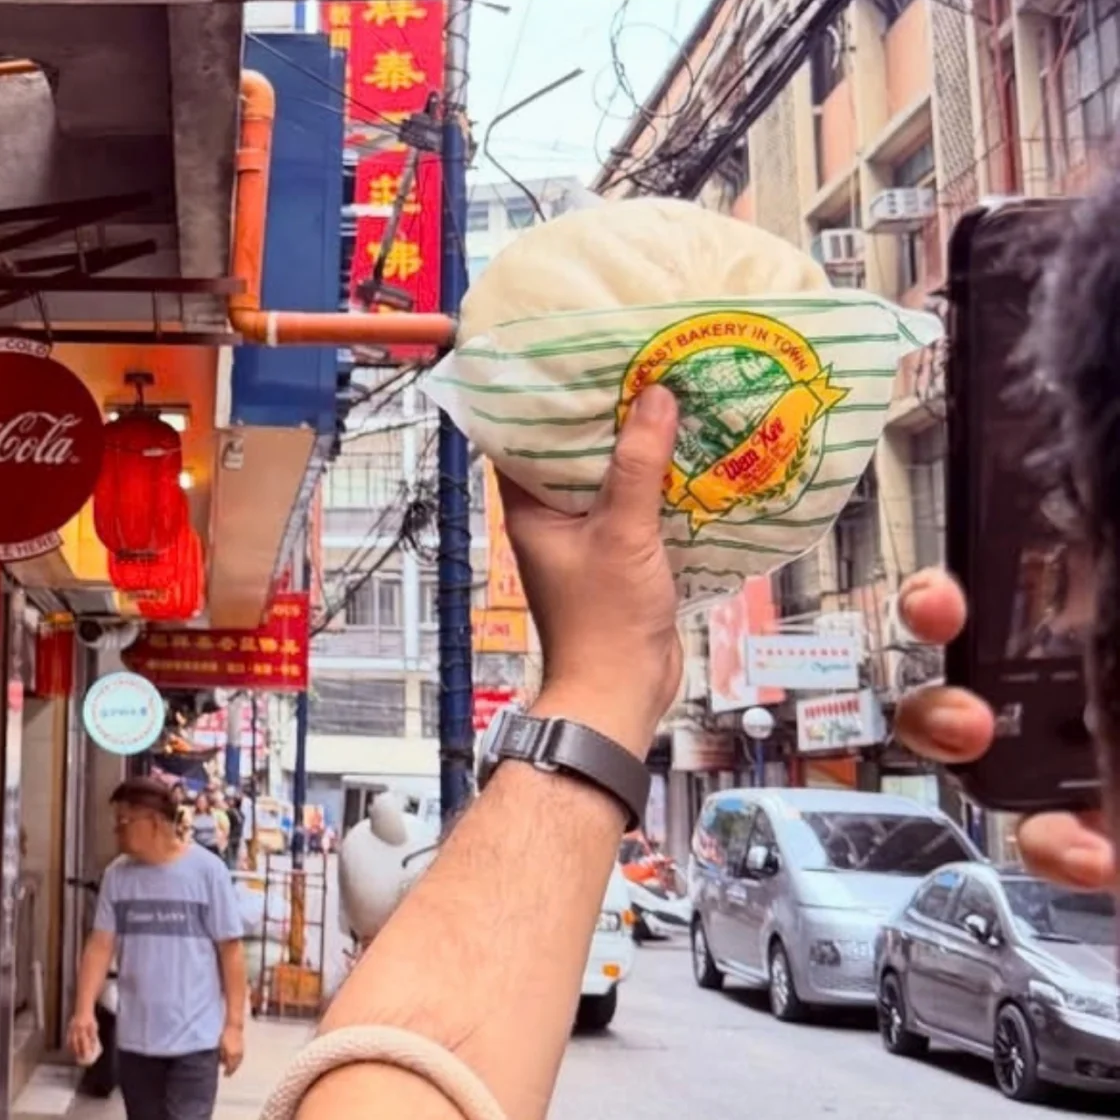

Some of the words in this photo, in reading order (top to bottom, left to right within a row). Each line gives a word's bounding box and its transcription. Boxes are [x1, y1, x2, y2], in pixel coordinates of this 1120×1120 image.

[677, 323, 749, 347] BAKERY
[752, 326, 769, 342] IN
[773, 332, 809, 373] TOWN
